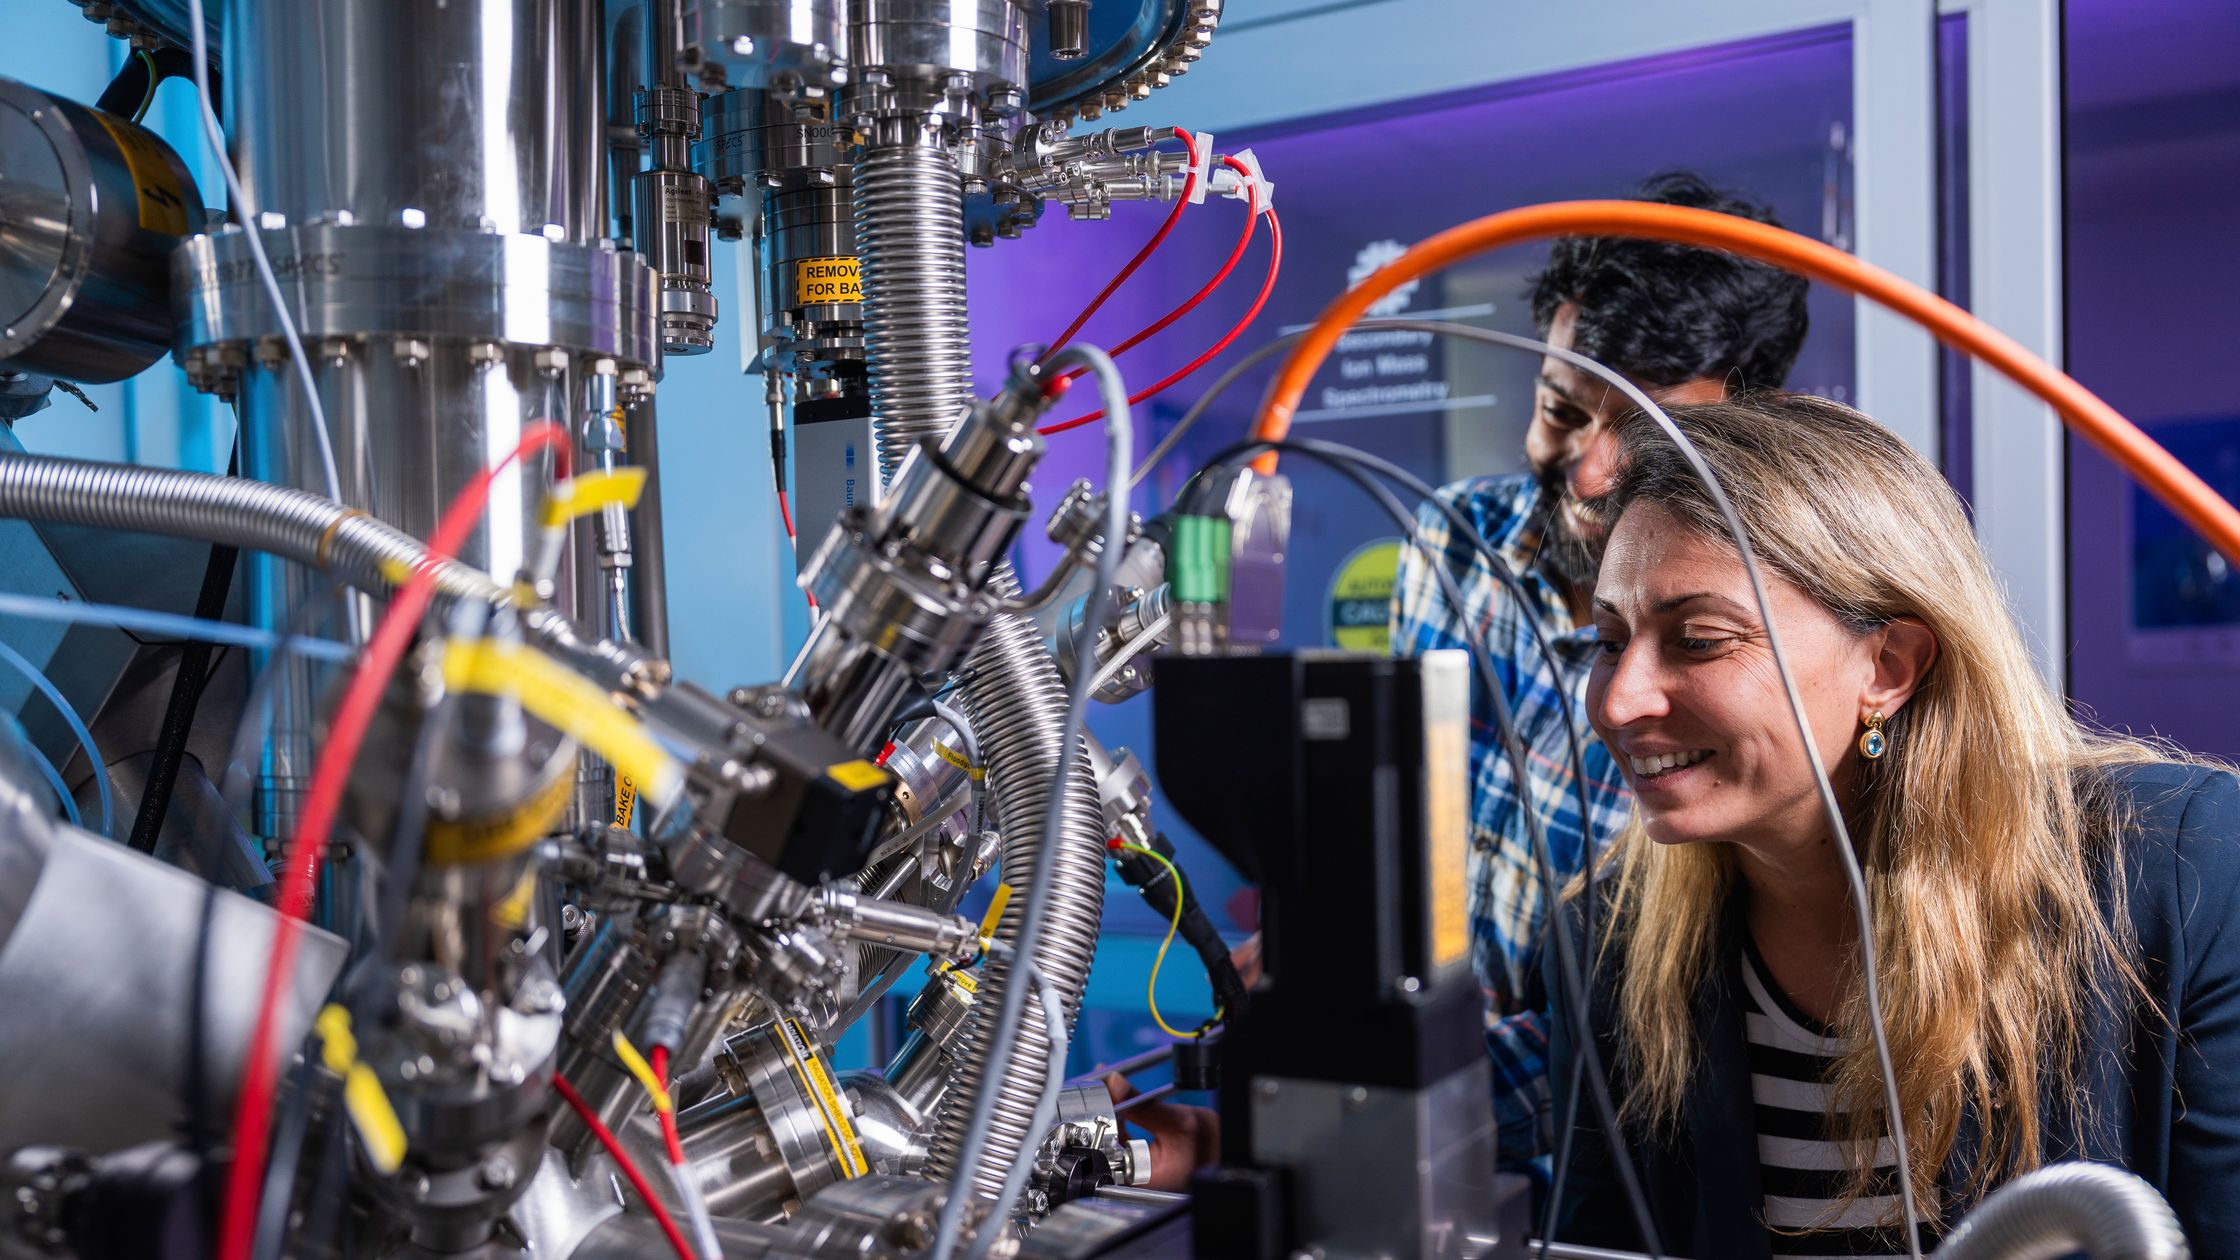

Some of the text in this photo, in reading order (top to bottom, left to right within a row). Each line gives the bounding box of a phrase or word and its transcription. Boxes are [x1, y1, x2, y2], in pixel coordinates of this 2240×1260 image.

[806, 282, 860, 296] FOR BA
[616, 787, 630, 826] BAKE
[811, 1062, 832, 1100] RADIATION
[829, 1100, 847, 1130] SHIELD
